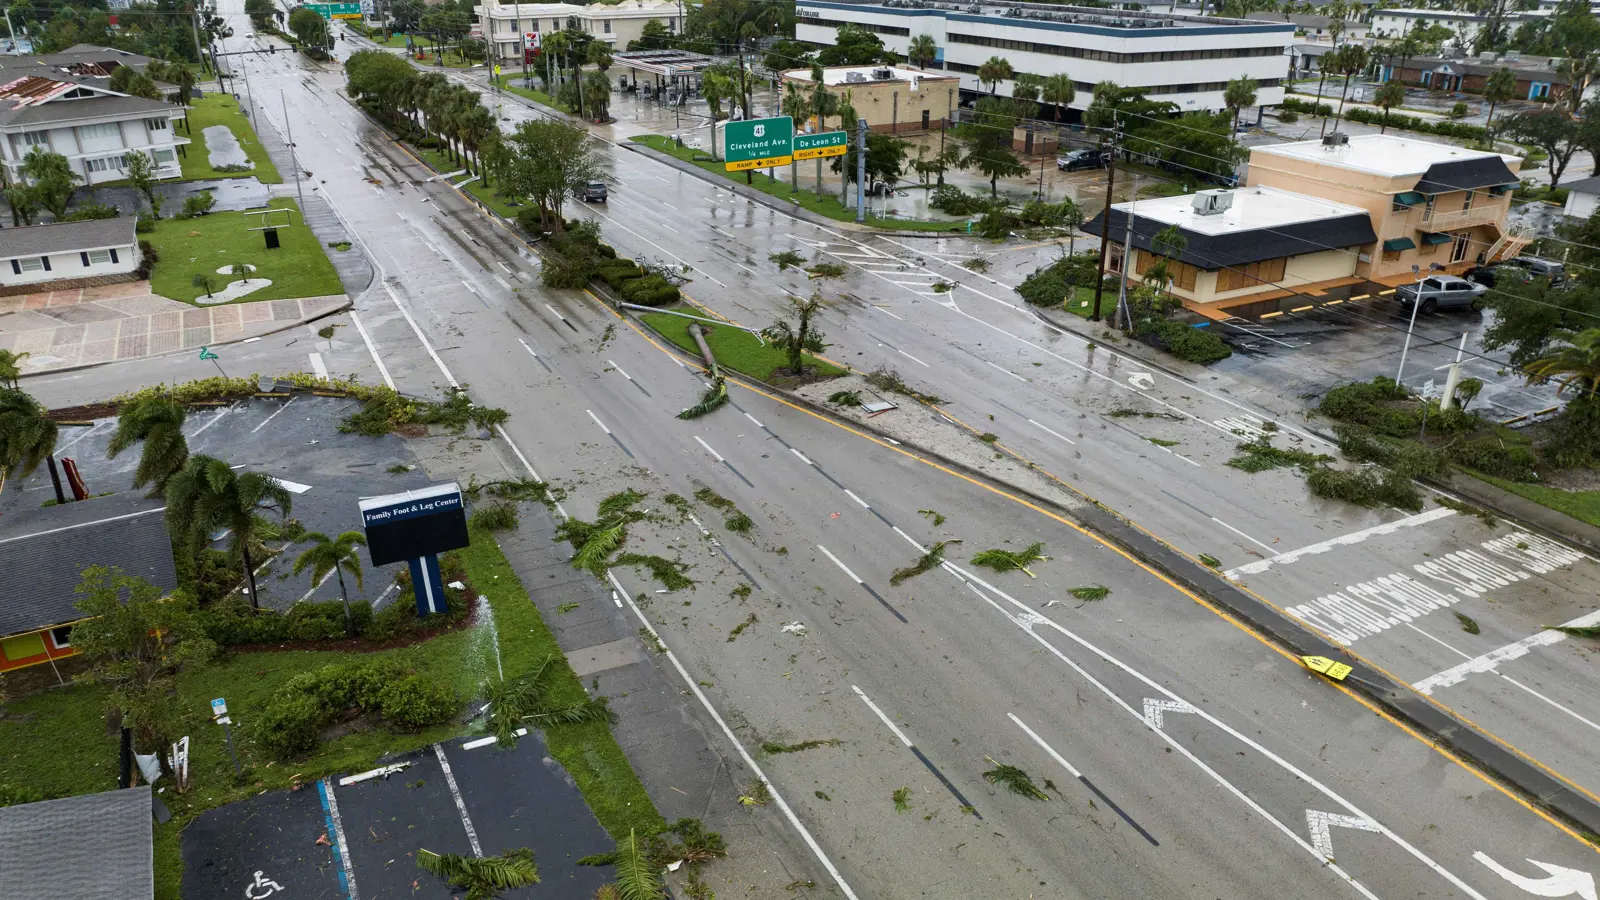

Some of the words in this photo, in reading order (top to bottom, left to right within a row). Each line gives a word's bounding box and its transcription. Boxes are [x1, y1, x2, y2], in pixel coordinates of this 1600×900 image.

[730, 140, 768, 150] Cleveland
[812, 138, 829, 146] Leon
[366, 510, 392, 521] Family
[393, 506, 409, 516] Foot
[435, 498, 458, 507] Center
[1413, 549, 1531, 598] SCHOOL
[1481, 531, 1585, 574] SCHOOL
[1285, 591, 1401, 646] SCHOOL
[1346, 572, 1460, 622] SCHOOL
